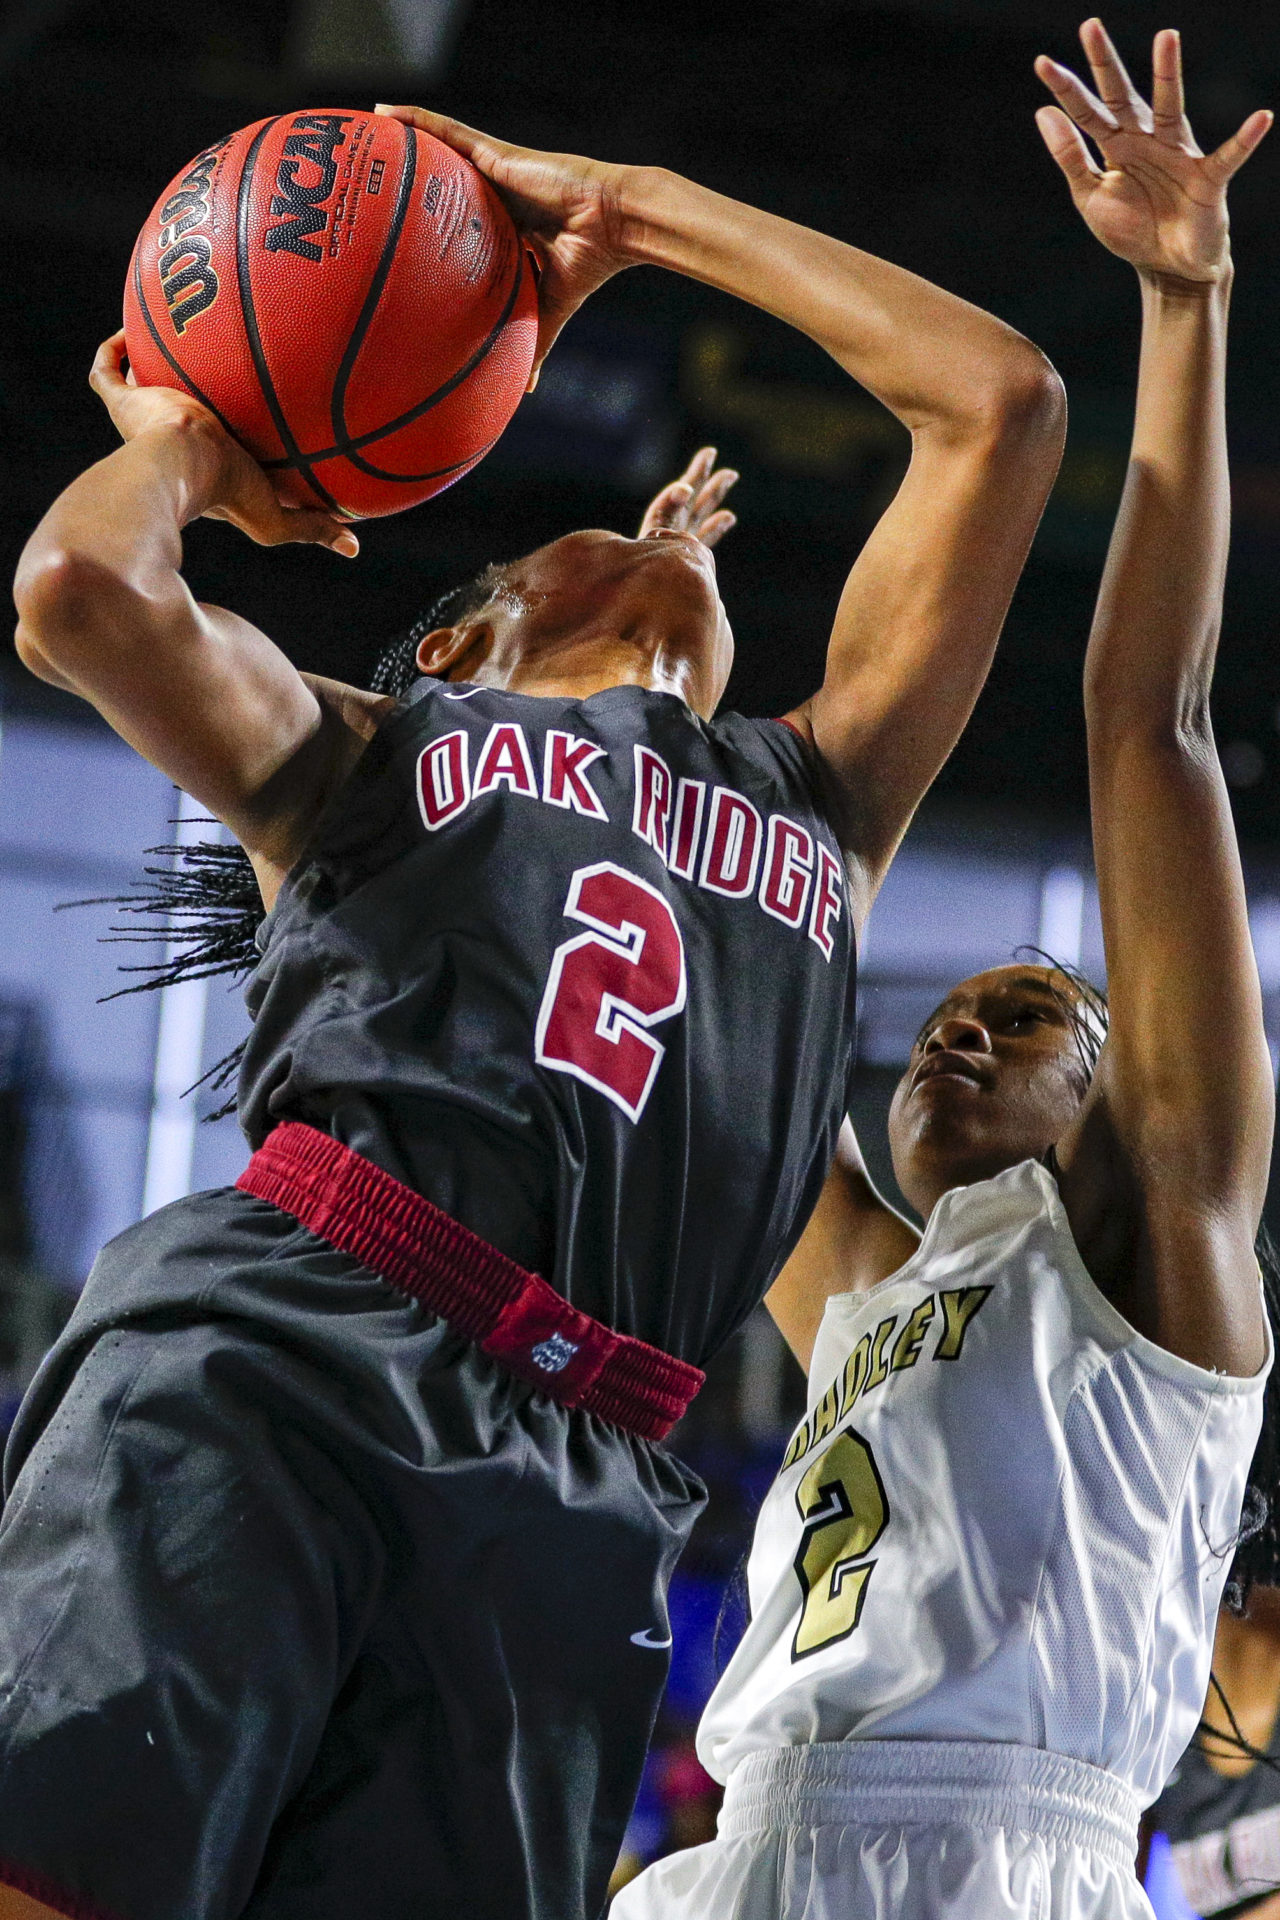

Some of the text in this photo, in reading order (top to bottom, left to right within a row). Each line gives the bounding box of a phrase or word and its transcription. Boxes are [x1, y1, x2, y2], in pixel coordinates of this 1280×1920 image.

[264, 115, 355, 264] NCAA
[344, 142, 360, 179] GAME
[416, 722, 843, 963] OAK RIDGE
[535, 861, 688, 1125] 2
[791, 1425, 890, 1664] 2
